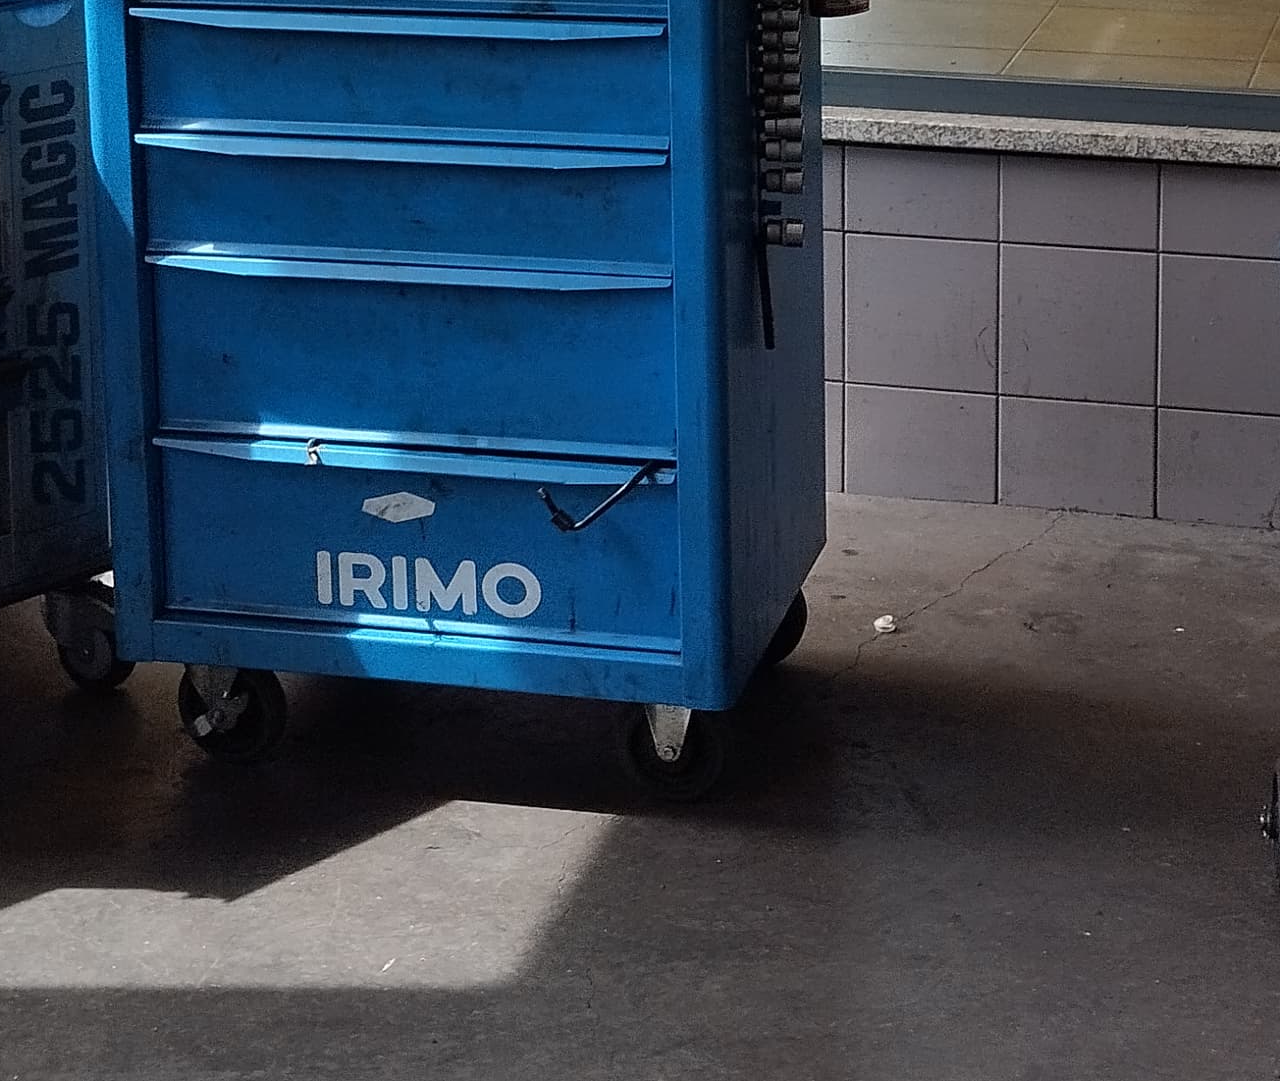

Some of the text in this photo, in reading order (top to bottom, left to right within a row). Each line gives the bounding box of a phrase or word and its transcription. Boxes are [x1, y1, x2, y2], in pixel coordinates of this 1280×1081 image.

[20, 78, 86, 505] 2525 MAGIC
[316, 550, 542, 618] IRIMO
